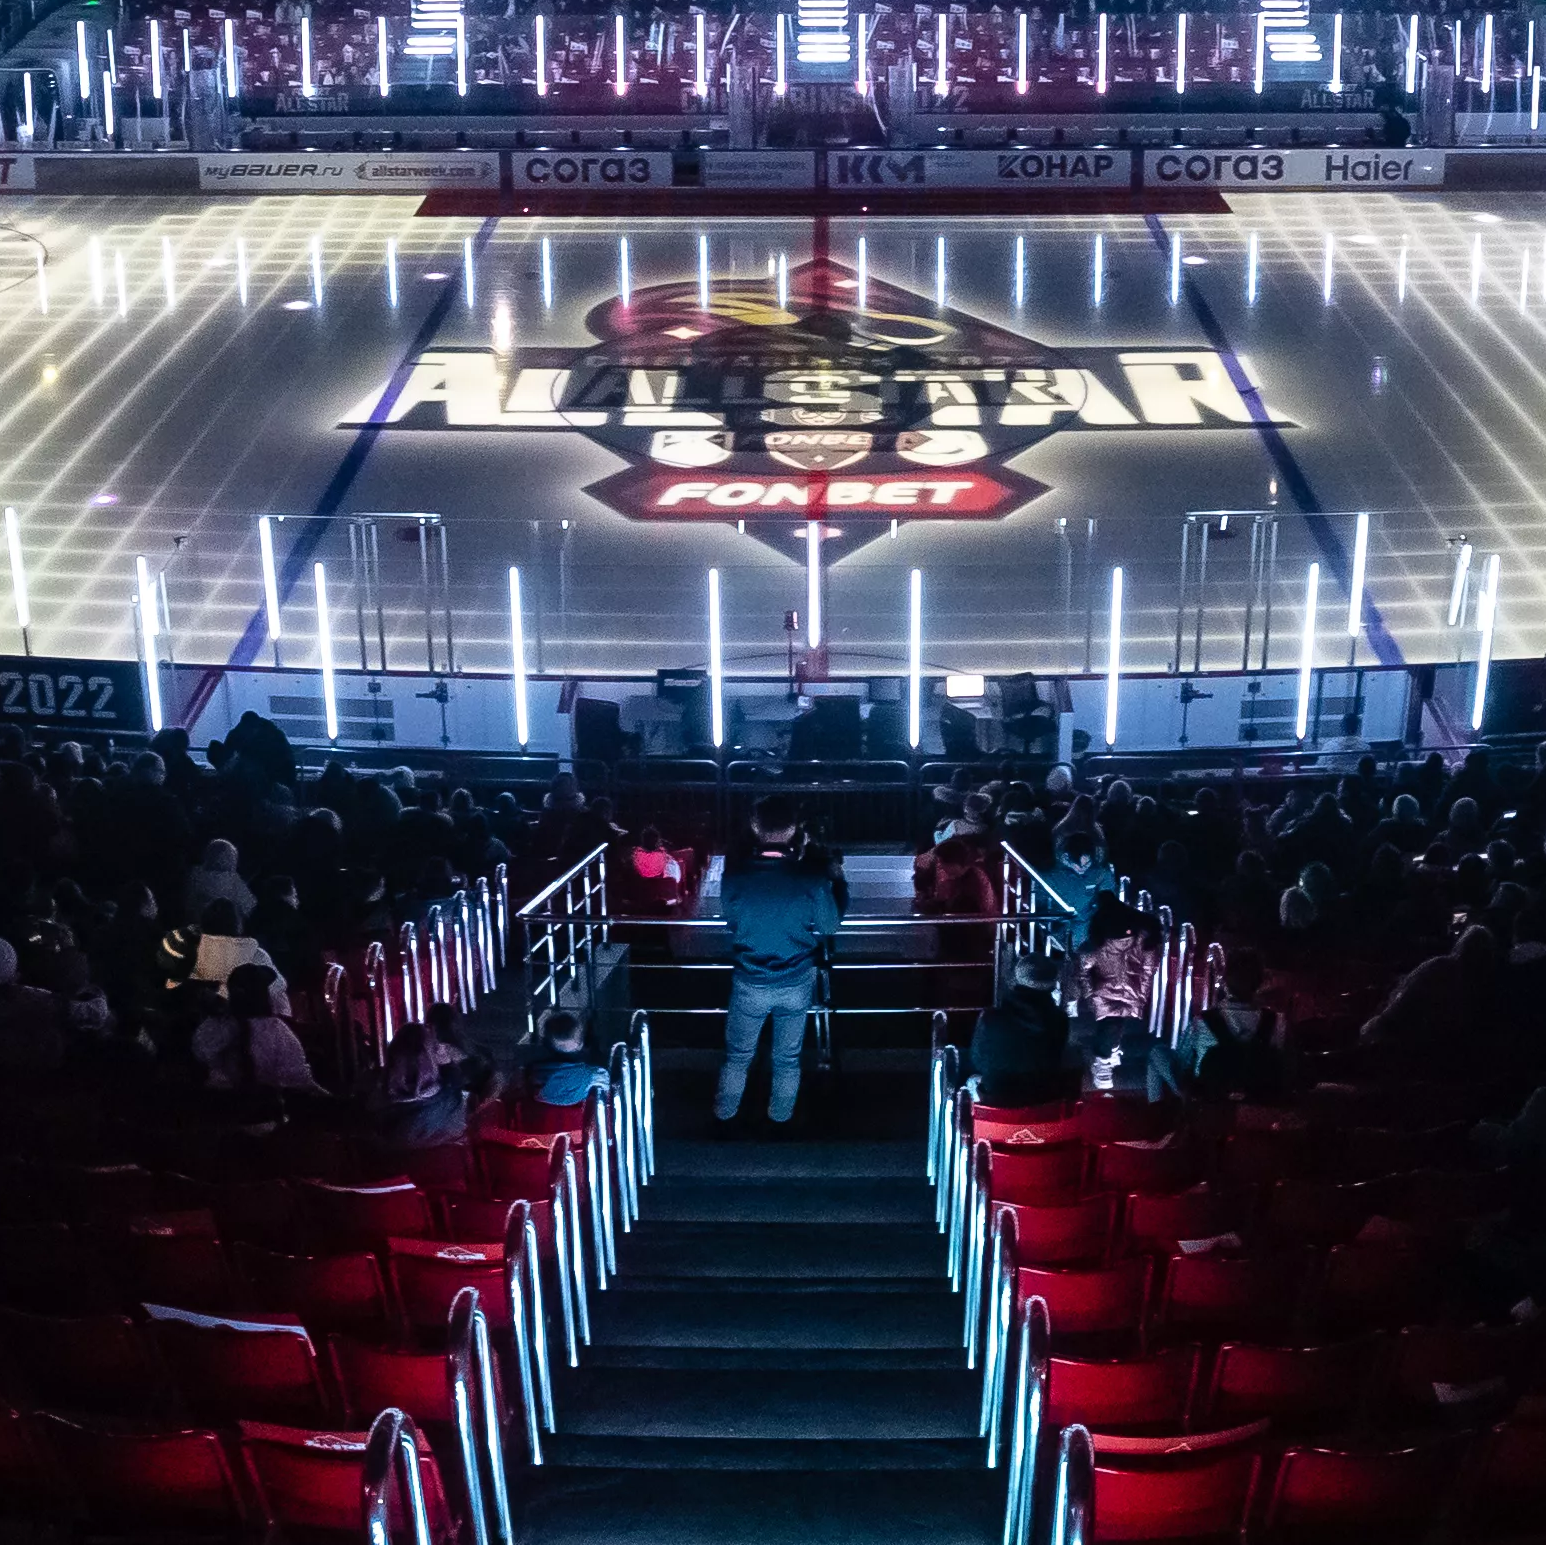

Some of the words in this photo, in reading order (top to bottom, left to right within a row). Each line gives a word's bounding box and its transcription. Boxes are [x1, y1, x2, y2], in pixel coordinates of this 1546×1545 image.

[998, 154, 1114, 180] КОНАР
[1325, 153, 1413, 182] Haier
[658, 480, 975, 506] FONBET
